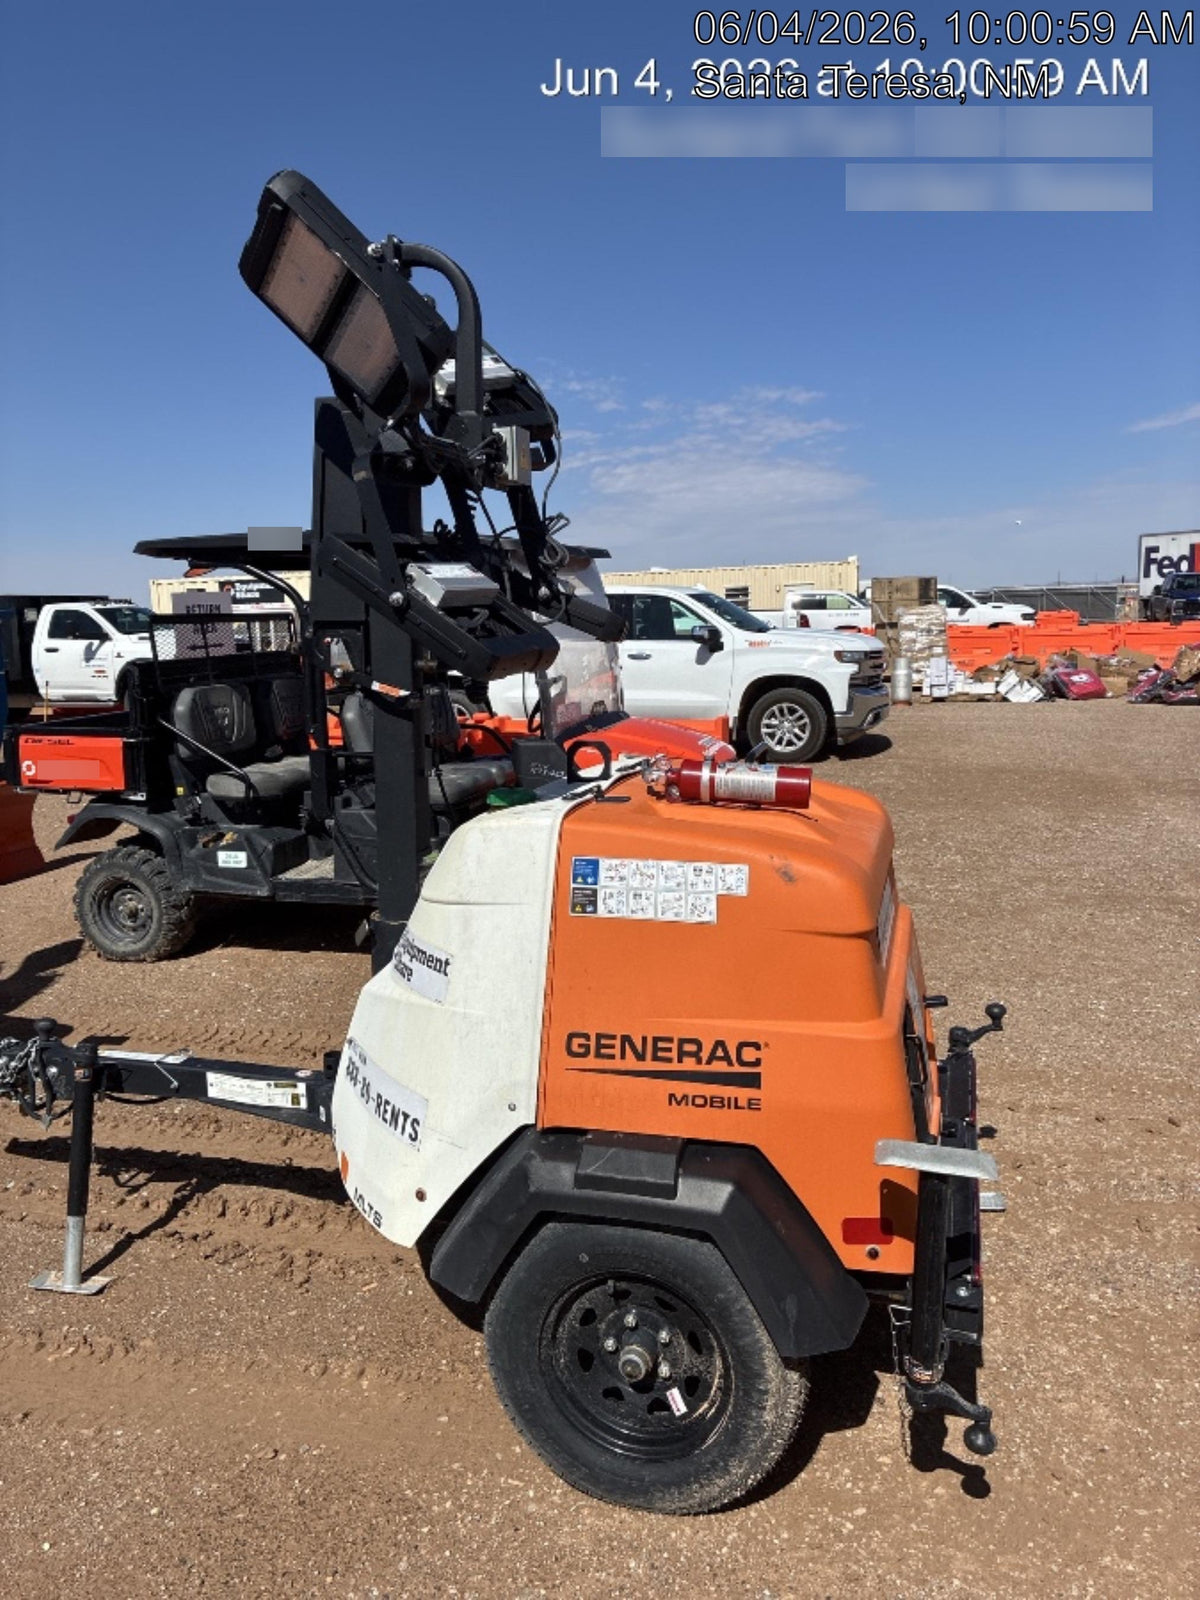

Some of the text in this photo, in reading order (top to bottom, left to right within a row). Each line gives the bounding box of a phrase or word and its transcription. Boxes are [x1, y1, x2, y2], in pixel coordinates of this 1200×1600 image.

[1143, 543, 1200, 579] Fed
[565, 1031, 762, 1068] GENERAC
[667, 1092, 762, 1111] MOBILE
